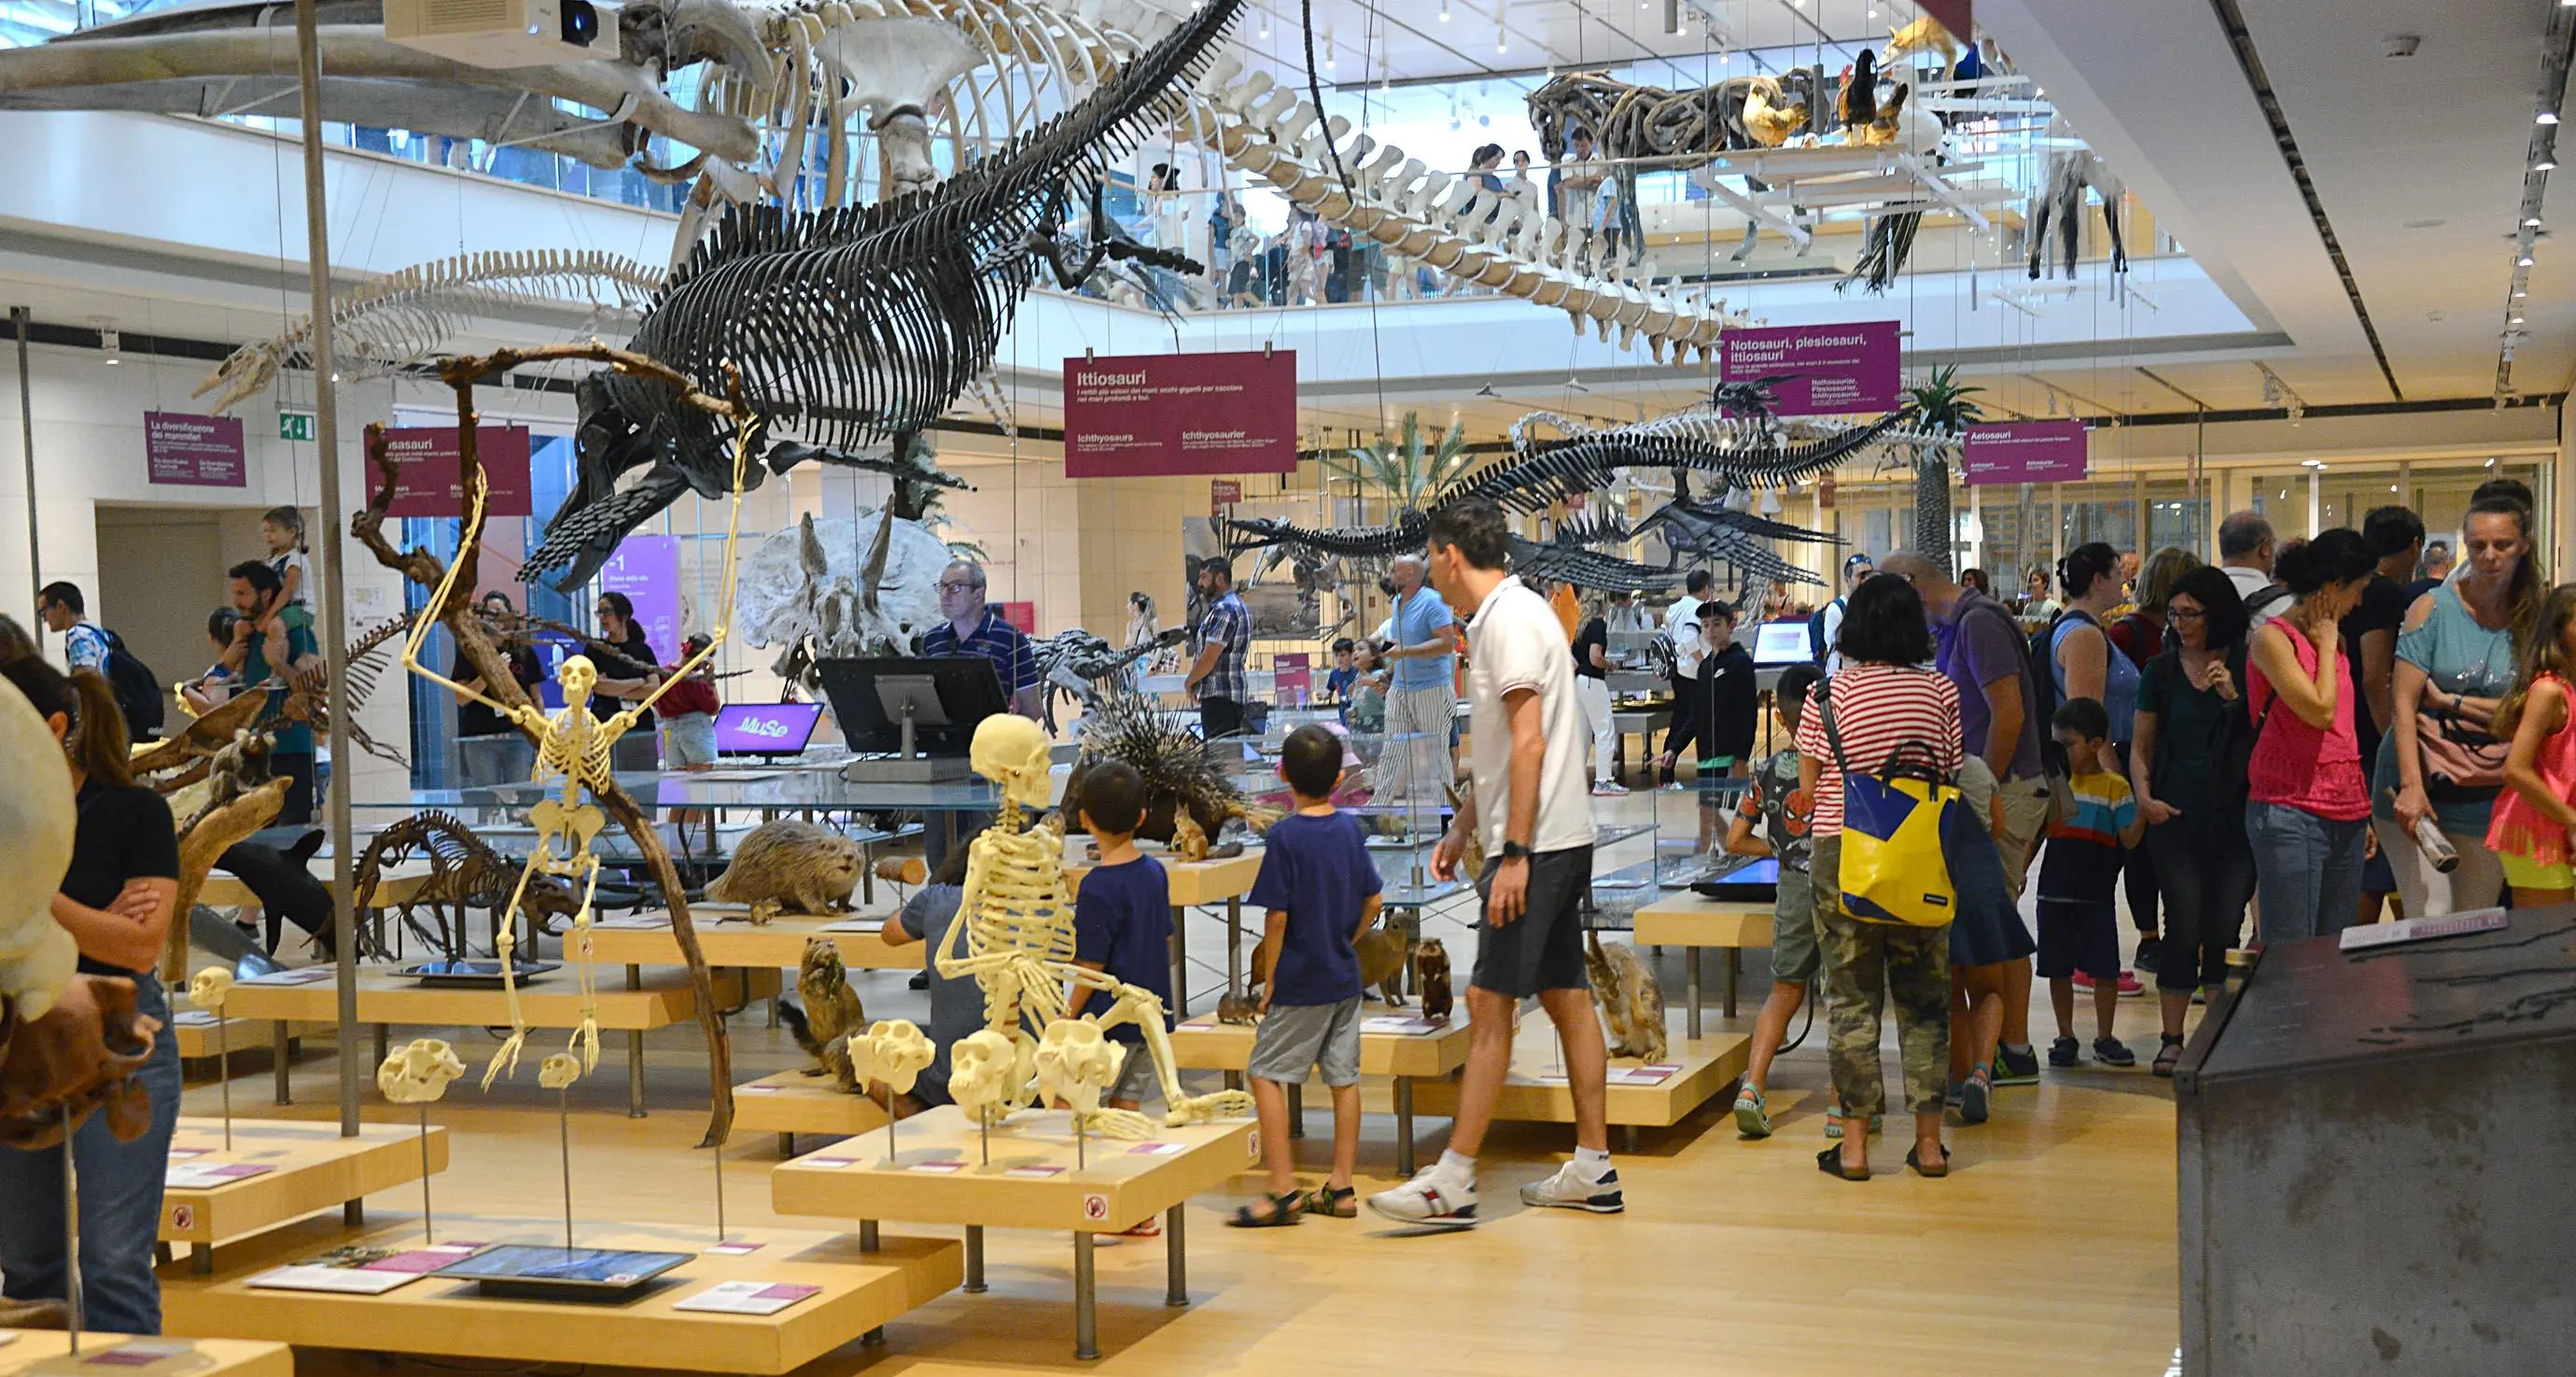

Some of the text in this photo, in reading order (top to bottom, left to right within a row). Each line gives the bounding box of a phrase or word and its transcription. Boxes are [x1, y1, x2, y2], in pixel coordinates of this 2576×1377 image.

[1730, 333, 1867, 352] Notosauri, plesiosauri,
[1730, 350, 1784, 364] ittiosauri
[1077, 370, 1146, 386] Ittiosauri
[151, 420, 161, 430] La
[1077, 433, 1134, 443] Ichthyosaurs
[1183, 430, 1246, 441] Ichthyosaurier
[1971, 430, 2011, 441] Aetosauri
[387, 438, 432, 450] sasauri
